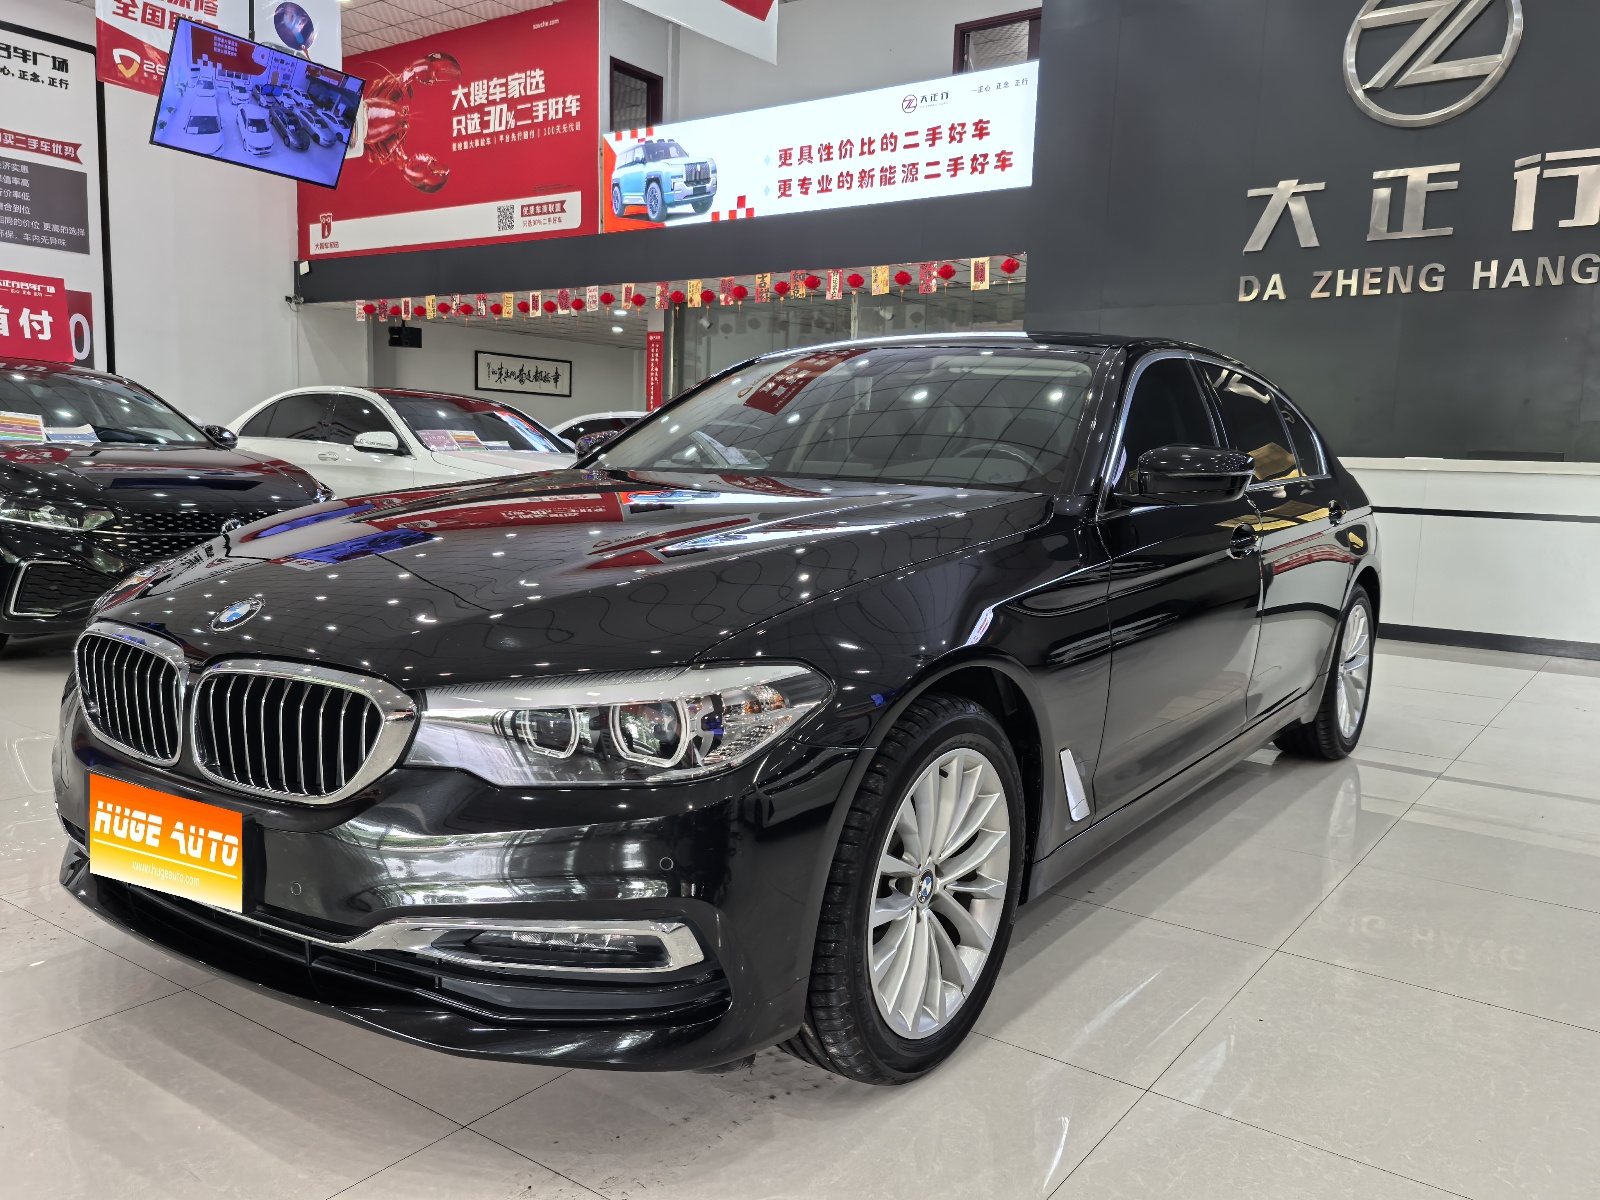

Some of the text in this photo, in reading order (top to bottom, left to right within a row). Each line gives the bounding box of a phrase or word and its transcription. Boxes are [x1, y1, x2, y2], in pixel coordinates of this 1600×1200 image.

[451, 68, 546, 111] 大搜车家选
[452, 94, 581, 138] 只选30%二手好车
[0, 132, 75, 158] 买二手车优势
[777, 118, 991, 168] 更具性价比的二手好车
[777, 149, 1014, 199] 更专业的新能源二手好车
[1242, 147, 1600, 256] 大正行
[1238, 252, 1600, 302] DA ZHENG HANG
